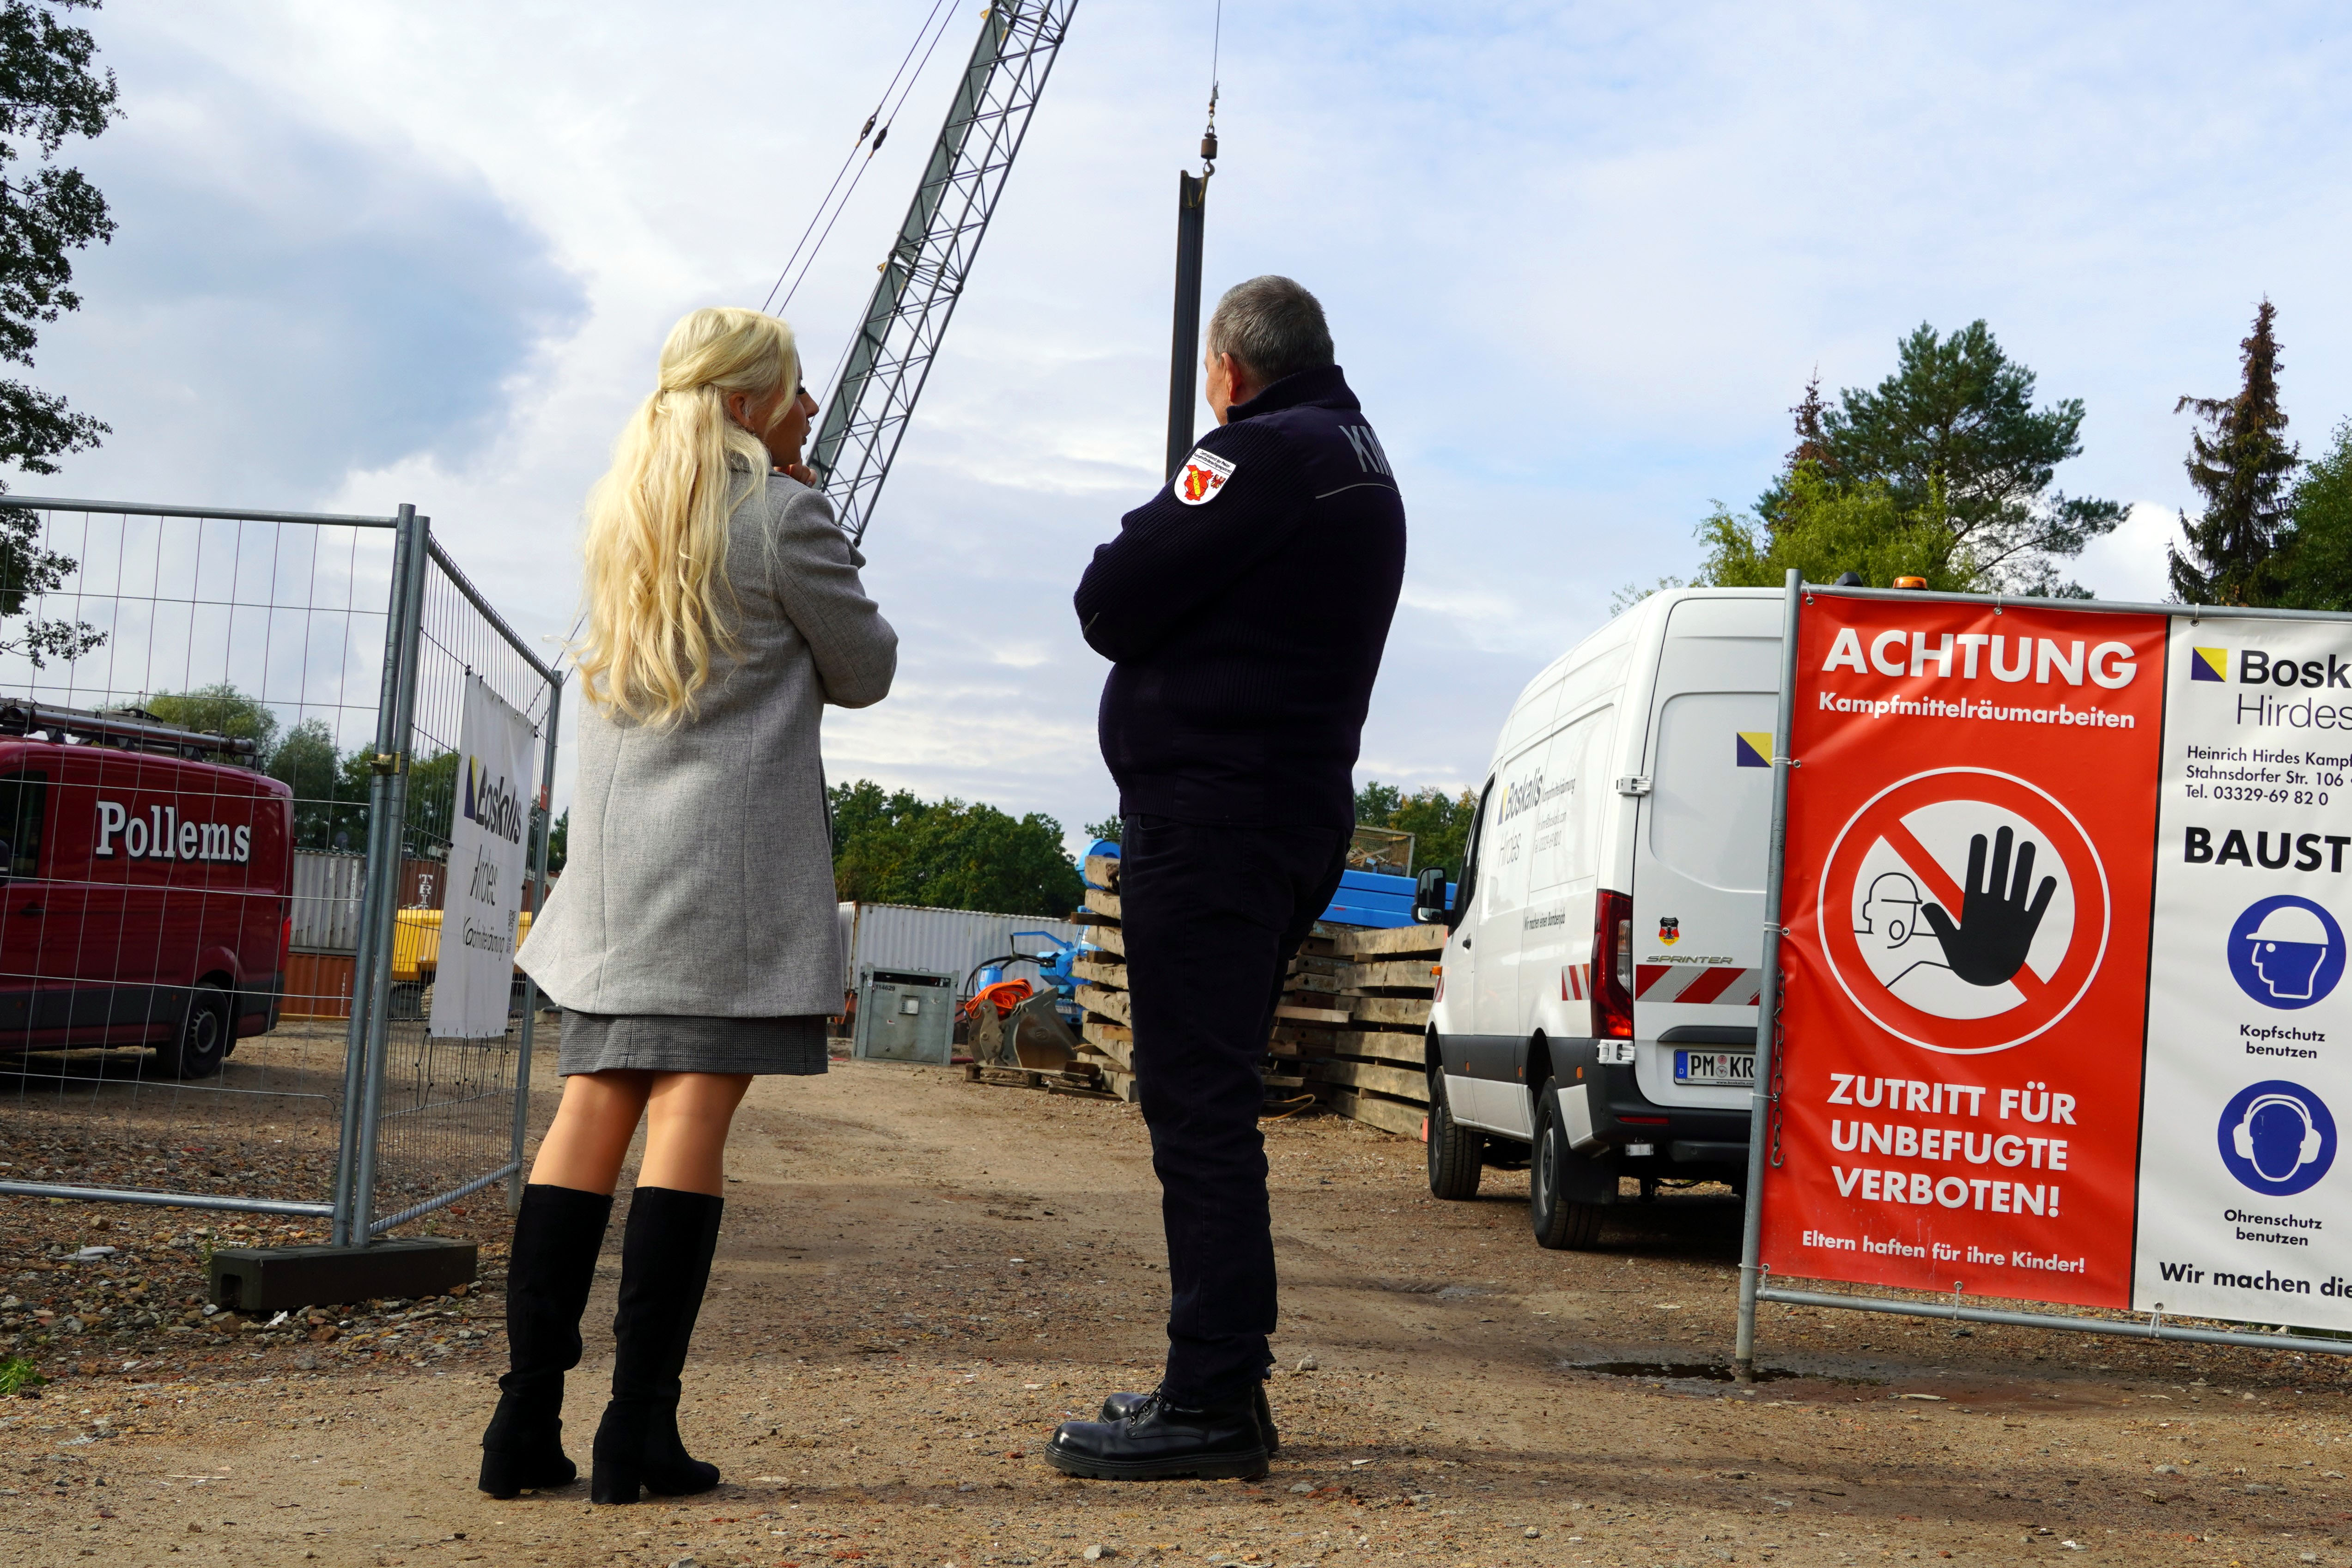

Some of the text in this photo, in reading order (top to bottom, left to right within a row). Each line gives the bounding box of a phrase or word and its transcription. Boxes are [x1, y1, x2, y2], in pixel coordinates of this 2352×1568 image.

[1821, 628, 2137, 689] ACHTUNG
[2240, 650, 2352, 689] Bosk
[1819, 692, 2135, 729] Kampfmittelräumarbeiten
[2237, 693, 2352, 730] Hirdes
[2187, 745, 2247, 762] Heinrich
[2253, 748, 2300, 765] Hirdes
[1505, 766, 1543, 822] Boskalis
[2187, 765, 2344, 787] Stahnsdorfer Str. 106
[2186, 785, 2329, 806] Tel. 03329-69 82 0
[96, 800, 250, 863] Pollems
[2184, 826, 2352, 873] BAUST
[1529, 912, 1539, 930] machen
[1539, 912, 1548, 928] einen
[1646, 954, 1733, 964] SPRINTER
[2240, 1024, 2326, 1043] Kopfschutz
[2245, 1041, 2317, 1059] benutzen
[1690, 1055, 1714, 1076] PM
[1827, 1073, 2077, 1125] ZUTRITT FÜR
[1831, 1119, 2068, 1171] UNBEFUGTE
[1831, 1166, 2060, 1218] VERBOTEN!
[2224, 1209, 2322, 1230] Ohrenschutz
[2236, 1227, 2309, 1246] benutzen
[1802, 1230, 2085, 1274] Eltern haften für ihre Kinder!
[2159, 1261, 2352, 1298] Wir machen die
